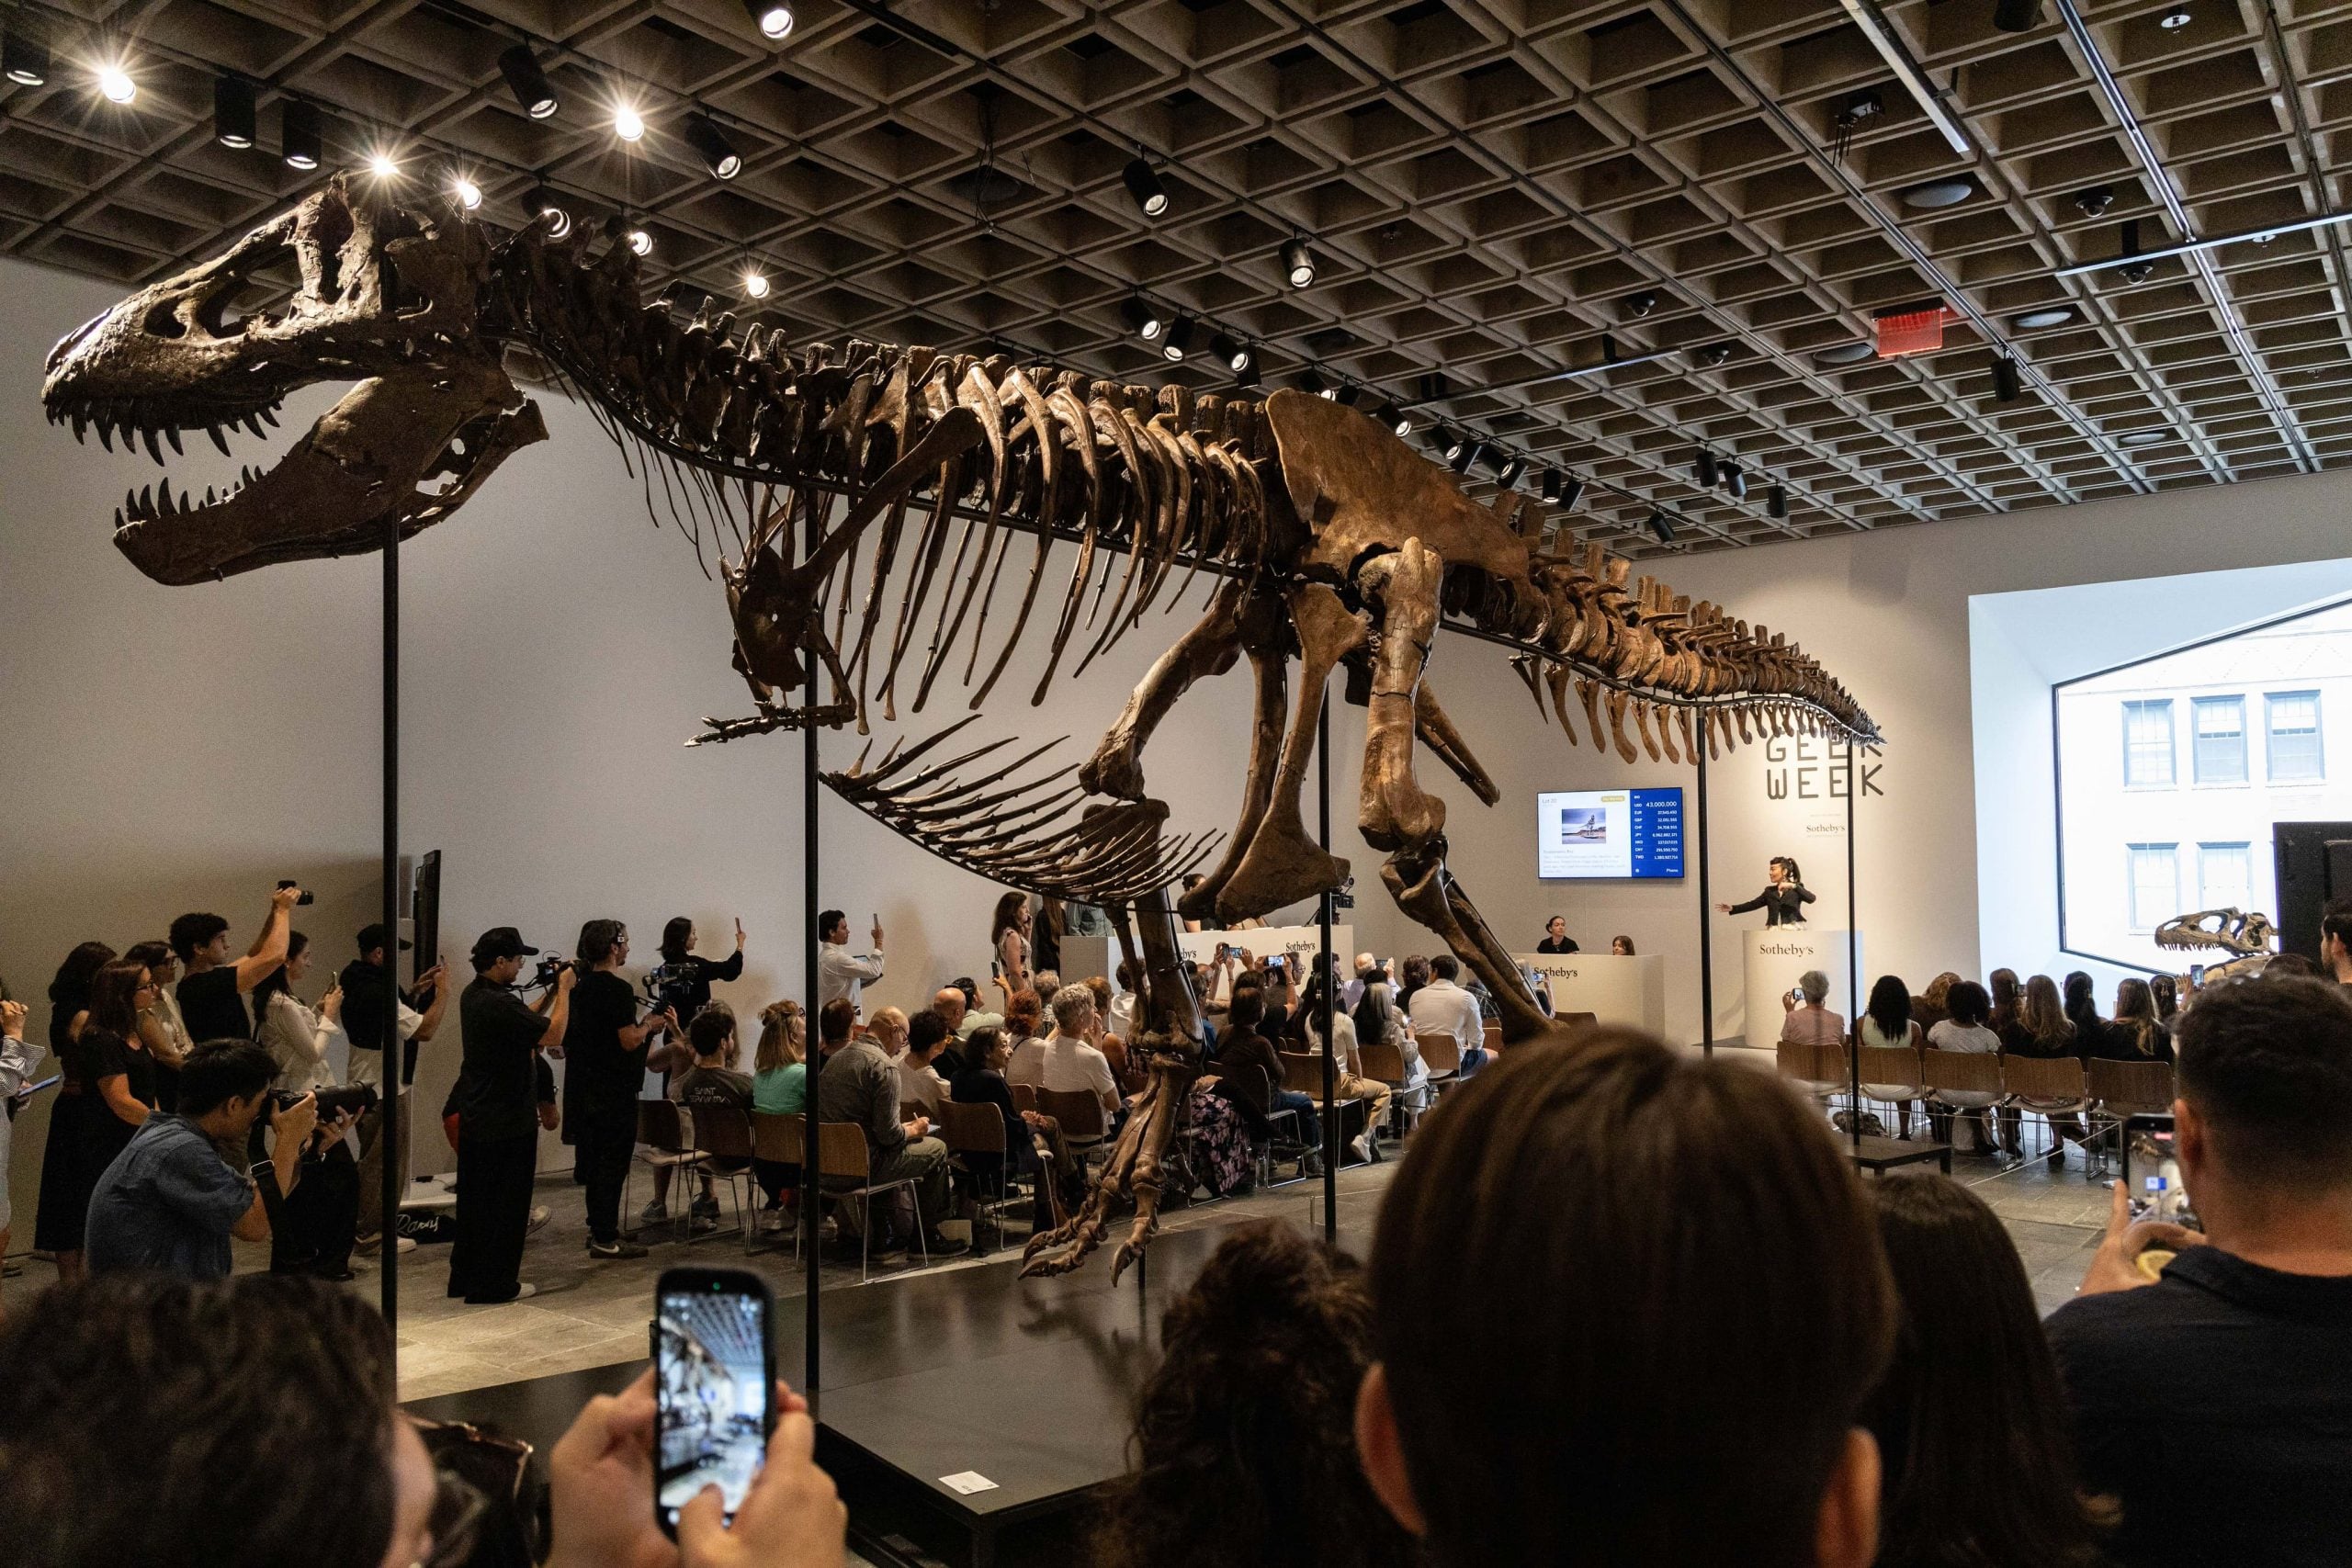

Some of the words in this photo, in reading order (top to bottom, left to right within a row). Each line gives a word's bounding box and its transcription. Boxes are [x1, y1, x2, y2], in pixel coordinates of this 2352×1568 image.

[1767, 764, 1883, 800] WEEK
[1806, 824, 1846, 833] Sotheby's
[1285, 941, 1316, 953] Sotheby's
[1758, 943, 1815, 957] Sotheby's
